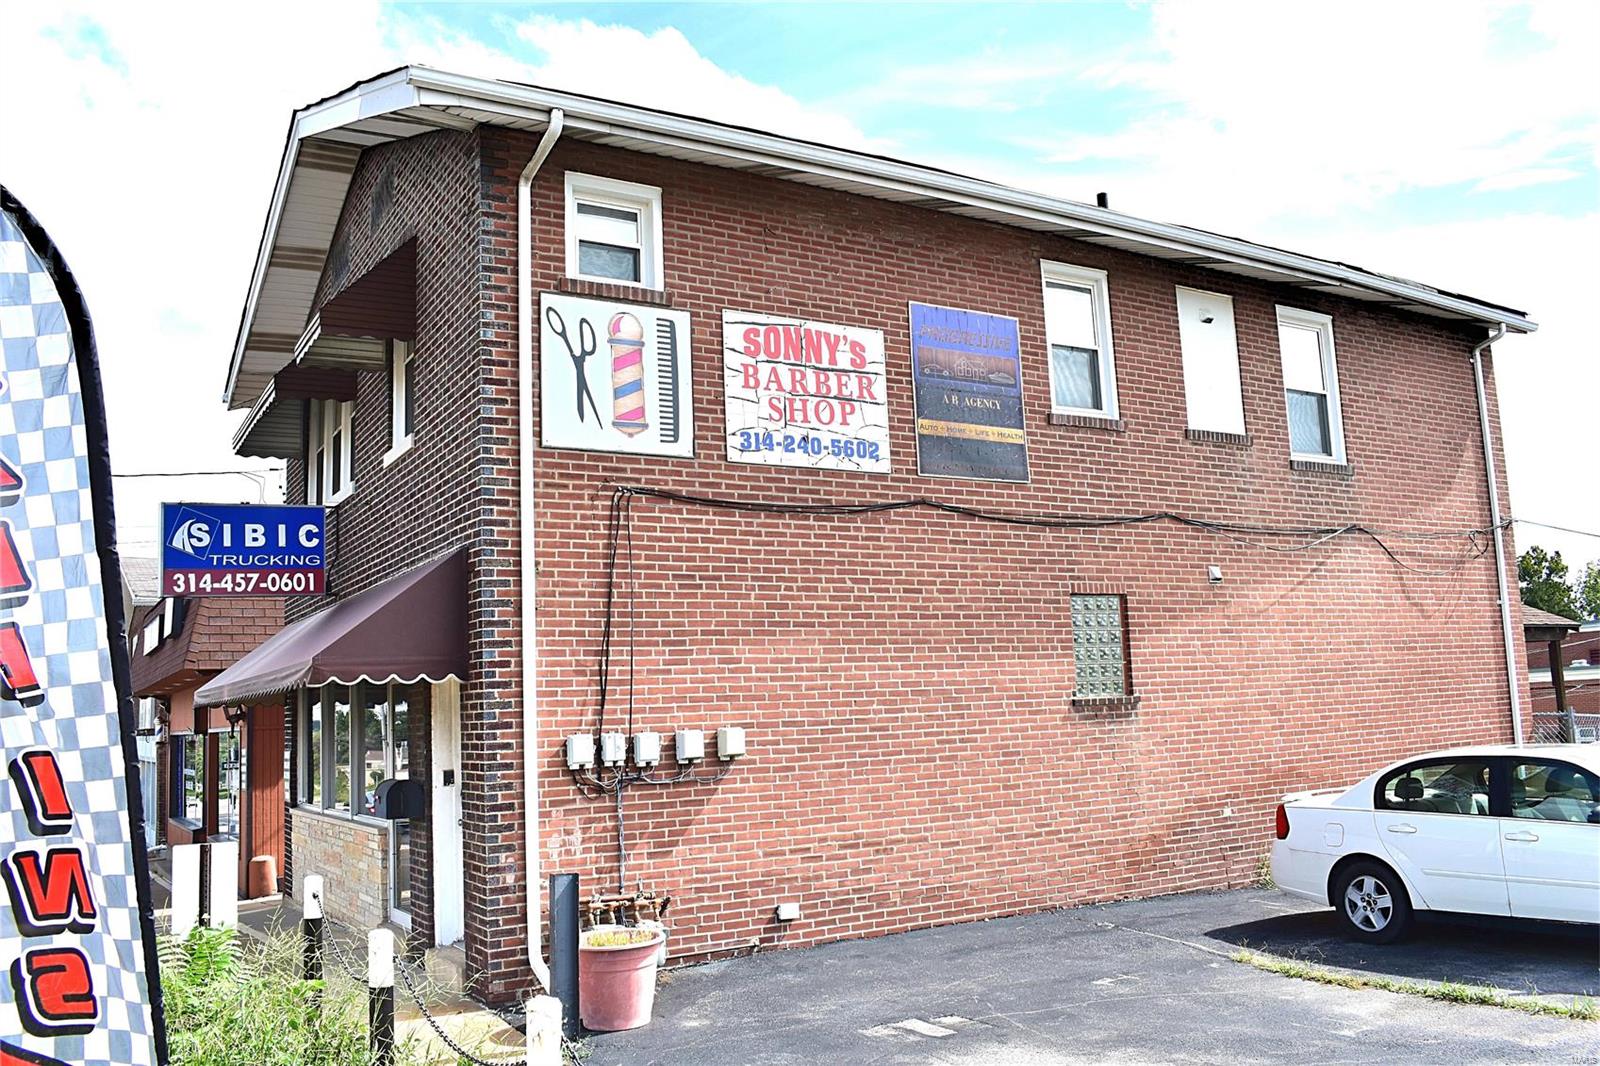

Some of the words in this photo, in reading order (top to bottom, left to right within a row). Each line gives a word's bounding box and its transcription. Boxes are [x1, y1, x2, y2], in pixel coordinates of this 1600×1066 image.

[743, 325, 867, 369] SONNY'S
[741, 363, 876, 399] BARBER
[768, 396, 856, 425] SHOP
[965, 397, 1001, 410] AGENCY
[739, 431, 880, 460] 314-240-5602
[190, 523, 320, 548] SIBIC
[209, 554, 320, 566] TRUCKING
[173, 573, 314, 593] 314-457-0601
